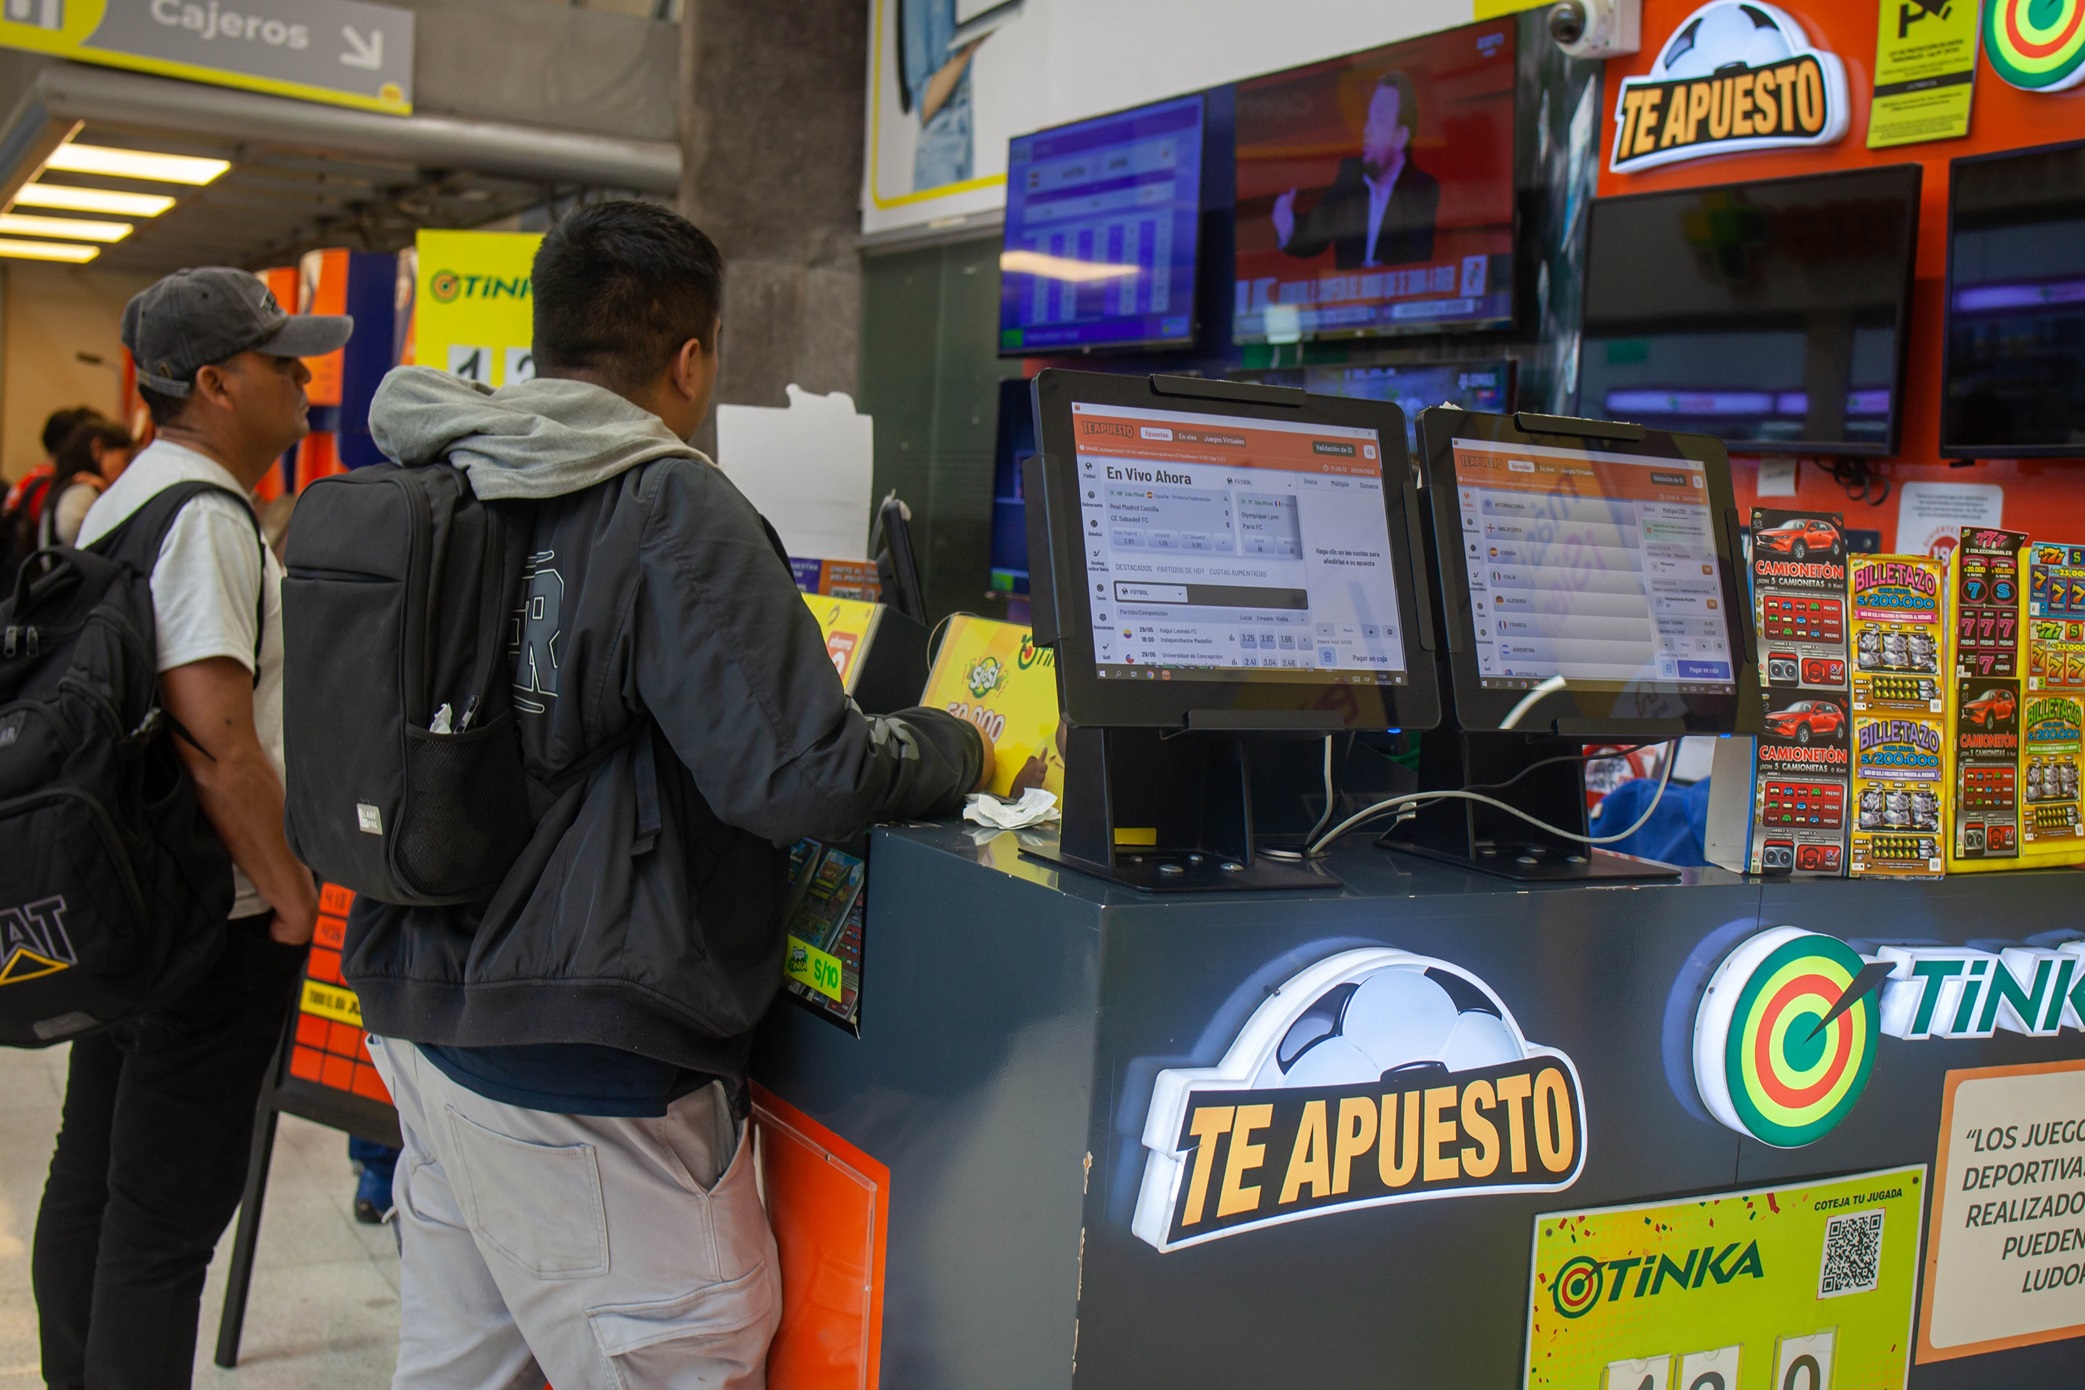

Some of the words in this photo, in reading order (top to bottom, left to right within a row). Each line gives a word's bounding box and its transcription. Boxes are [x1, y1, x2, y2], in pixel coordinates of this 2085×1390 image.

[149, 0, 310, 49] Cajeros
[1619, 87, 1663, 158] TE
[1660, 58, 1826, 146] APUESTO
[1145, 430, 1169, 440] Apuestas
[1204, 436, 1222, 444] Juegos
[1223, 437, 1245, 445] Virtuales
[1106, 466, 1122, 480] En
[1125, 467, 1151, 482] Vivo
[1155, 469, 1192, 485] Ahora
[1360, 482, 1379, 490] Sistema
[1109, 503, 1121, 511] Real
[1121, 503, 1137, 512] Madrid
[1138, 505, 1159, 513] Castilla
[1268, 513, 1279, 521] Lyon
[1116, 564, 1152, 572] DESTACADOS
[1157, 565, 1184, 574] PARTIDOS
[1194, 567, 1205, 575] HOY
[1209, 568, 1231, 576] CUOTAS
[1231, 569, 1267, 578] AUMENTADAS
[1755, 560, 1844, 580] CAMIONETÓN
[1854, 562, 1936, 596] BILLETAZO
[1771, 577, 1776, 585] 5
[1778, 578, 1825, 588] CAMIONETAS
[1967, 582, 1981, 599] 7
[1996, 583, 2011, 598] S
[2033, 570, 2047, 591] 7
[2052, 582, 2066, 603] 7
[2071, 584, 2085, 604] 7
[1961, 618, 1976, 637] 7
[1980, 618, 1995, 637] 7
[1999, 618, 2015, 638] 7
[1353, 655, 1367, 663] Pagar
[1376, 655, 1387, 663] caja
[1979, 655, 1995, 675] 7
[2032, 644, 2044, 667] 7
[2048, 656, 2063, 678] 7
[2069, 657, 2085, 679] 7
[2027, 698, 2082, 731] BILLETAZO
[1859, 720, 1940, 753] BILLETAZO
[1960, 730, 2017, 748] CAMIONETÓN
[1759, 745, 1848, 764] CAMIONETÓN
[1782, 763, 1828, 772] CAMIONETAS
[814, 958, 838, 988] S/10
[1183, 1105, 1274, 1224] TE
[1278, 1067, 1572, 1202] APUESTO
[1814, 1196, 1849, 1211] COTEJA
[1852, 1194, 1865, 1206] TU
[1867, 1187, 1903, 1203] JUGADA
